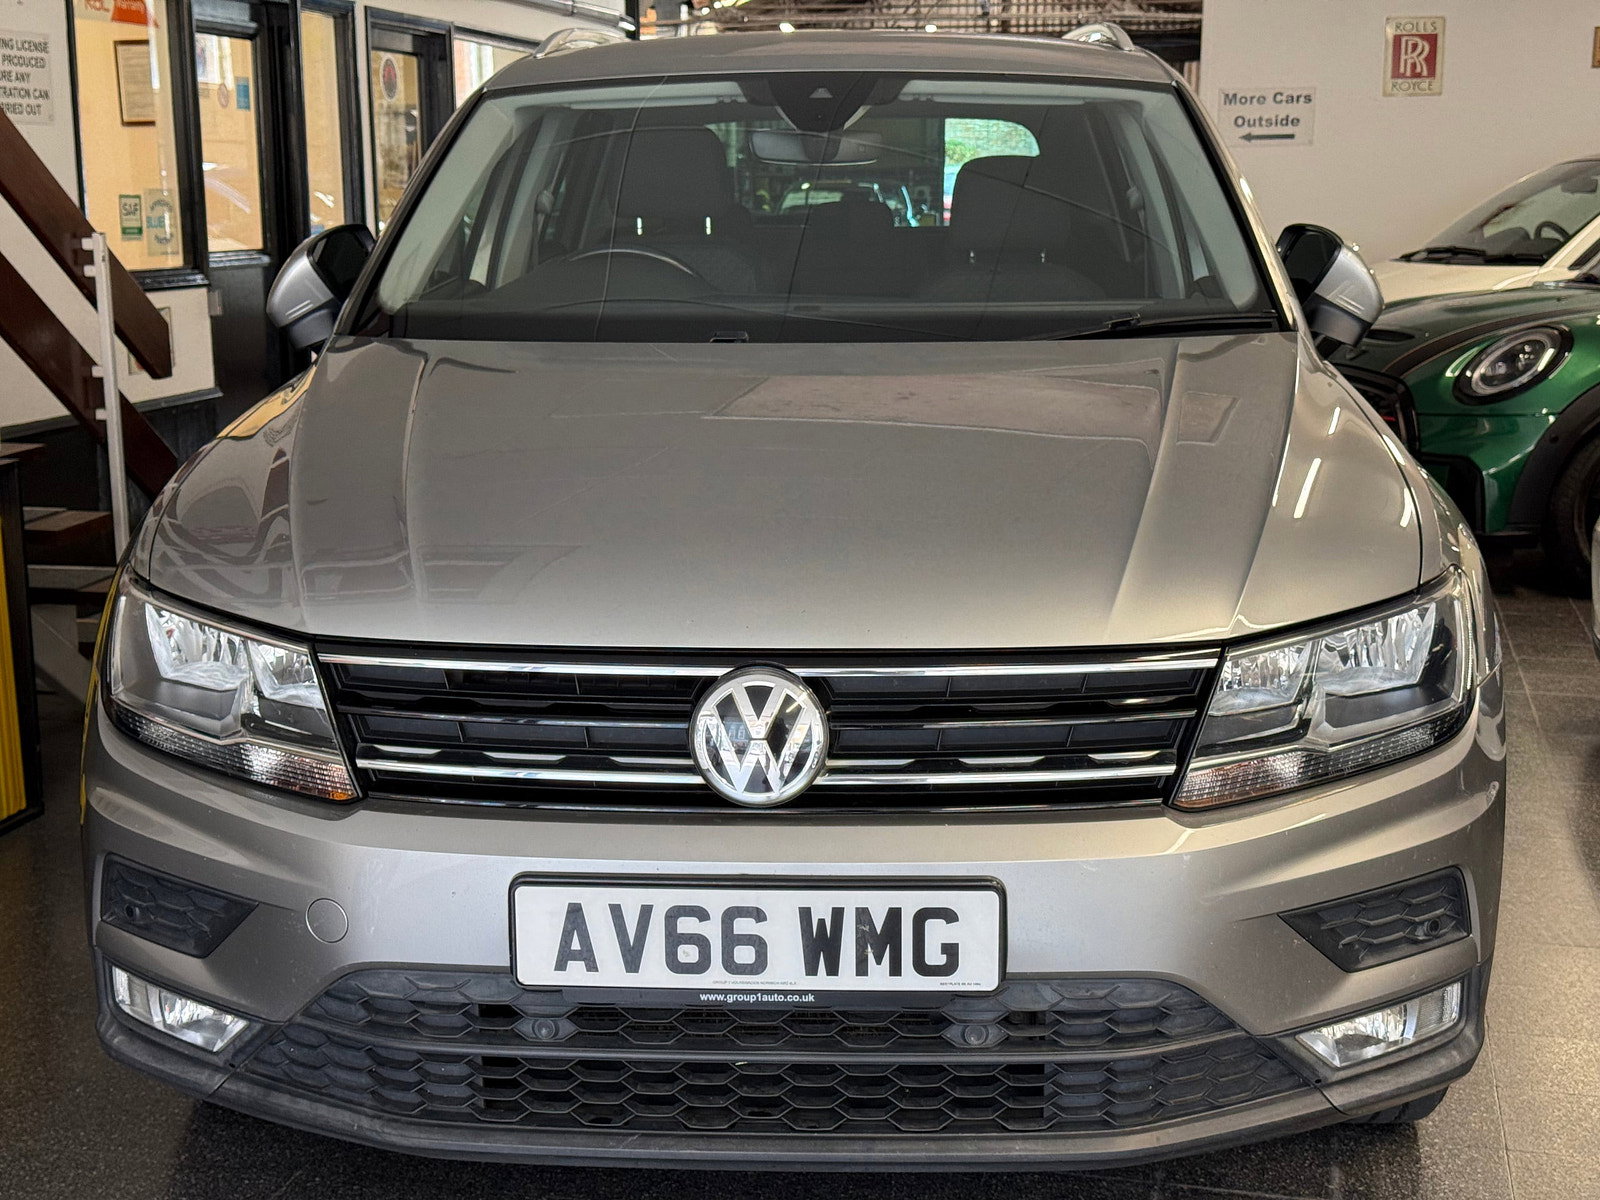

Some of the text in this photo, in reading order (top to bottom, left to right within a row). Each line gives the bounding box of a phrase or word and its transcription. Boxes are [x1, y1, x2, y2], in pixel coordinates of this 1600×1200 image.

[1395, 21, 1437, 32] ROLLS
[15, 40, 49, 54] LICENSE
[1, 54, 47, 69] PRODUCED
[14, 72, 31, 83] ANY
[1391, 81, 1433, 92] ROYCE
[32, 88, 50, 100] CAN
[1223, 92, 1313, 105] More Cars
[25, 103, 42, 116] OUT
[1234, 115, 1300, 127] Outside
[553, 902, 960, 977] AV66 WMG
[699, 993, 815, 1003] www.group1auto.co.uk
